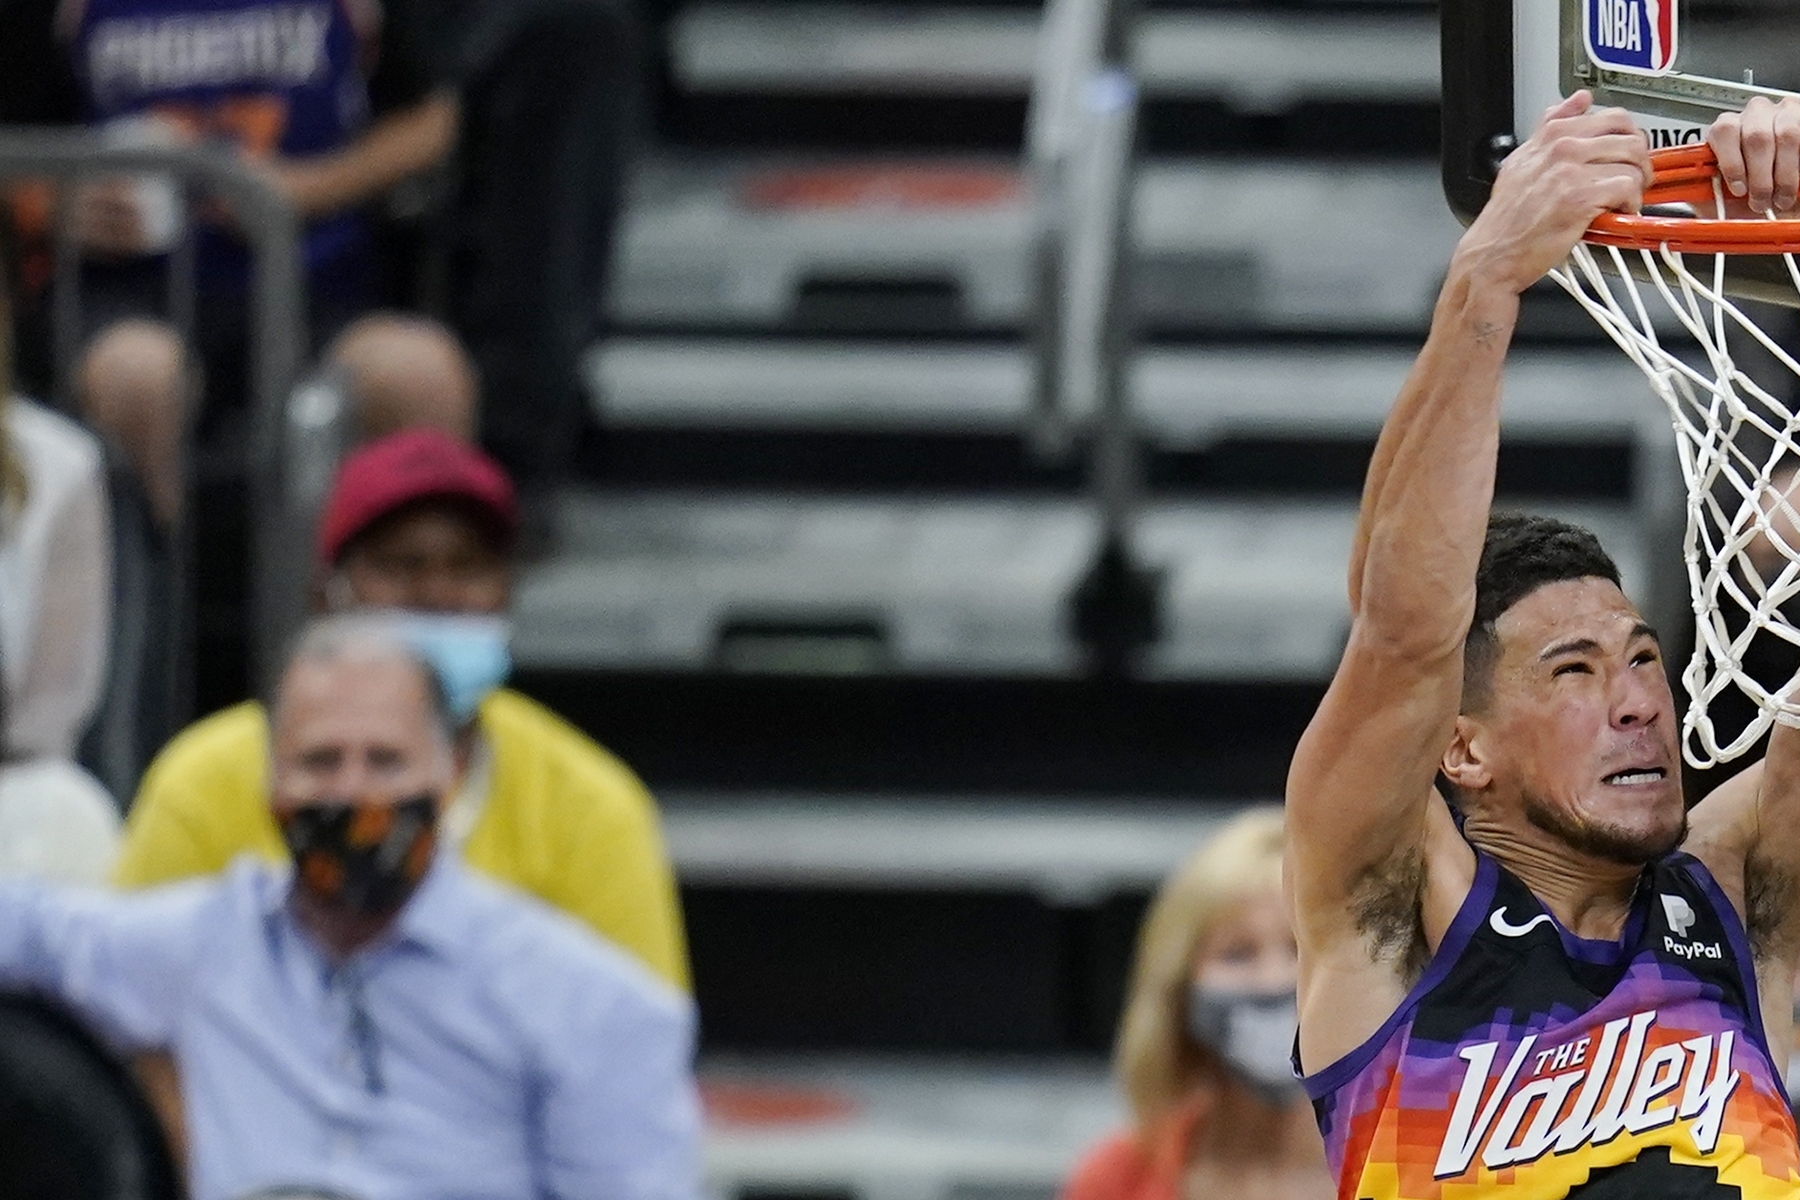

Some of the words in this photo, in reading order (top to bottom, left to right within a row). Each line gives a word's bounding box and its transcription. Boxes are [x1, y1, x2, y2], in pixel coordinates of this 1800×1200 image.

[1598, 0, 1642, 51] NBA
[1663, 935, 1722, 960] PayPal
[1533, 1037, 1591, 1076] THE
[1433, 1010, 1741, 1181] Valley
